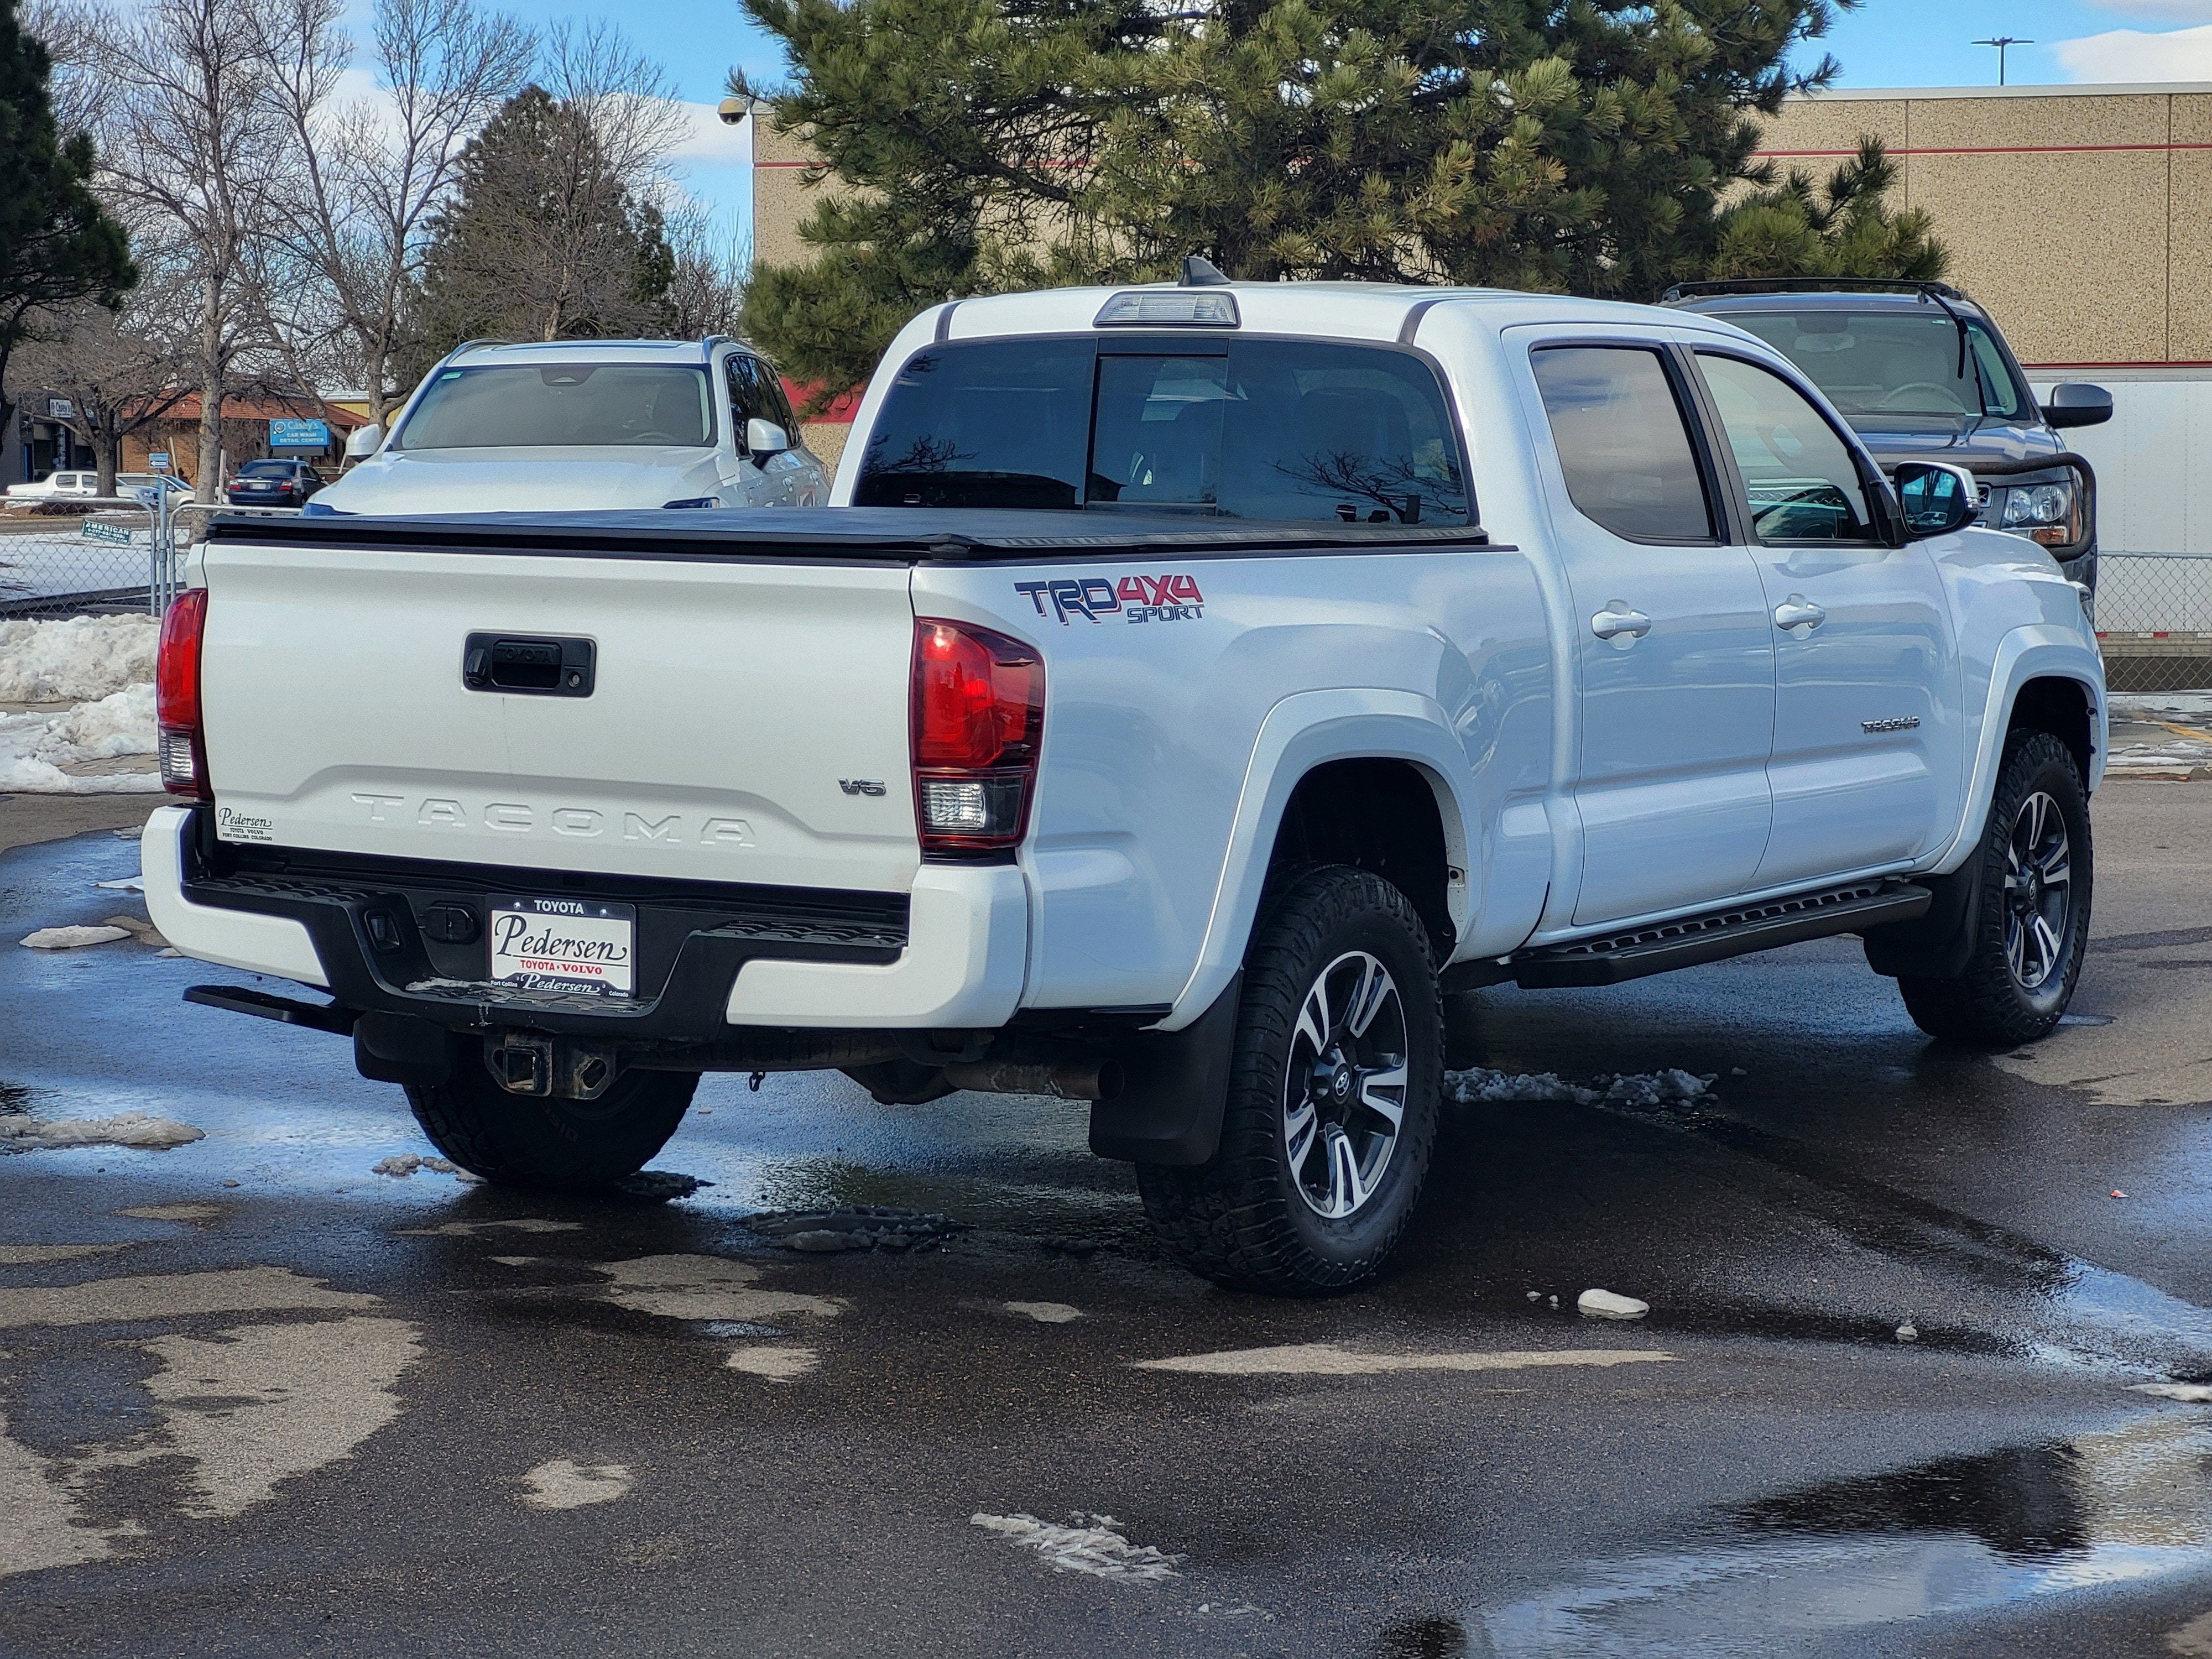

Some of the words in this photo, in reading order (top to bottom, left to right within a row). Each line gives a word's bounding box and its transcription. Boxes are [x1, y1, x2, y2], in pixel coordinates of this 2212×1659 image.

[288, 421, 319, 431] Casey's
[86, 522, 129, 535] AMERICAN
[1014, 578, 1122, 626] TRD
[1117, 576, 1203, 606] 4X4
[1127, 604, 1204, 624] SPORT
[497, 648, 554, 663] TOYOTA
[838, 778, 886, 796] V6
[219, 807, 272, 827] Pedersen
[351, 793, 755, 847] TACOMA
[534, 900, 585, 915] TOYOTA
[494, 915, 627, 961] Pedersen
[520, 959, 555, 971] TOYOTA
[561, 964, 603, 975] VOLVO
[520, 973, 601, 993] Pedersen
[608, 990, 629, 998] Colorado
